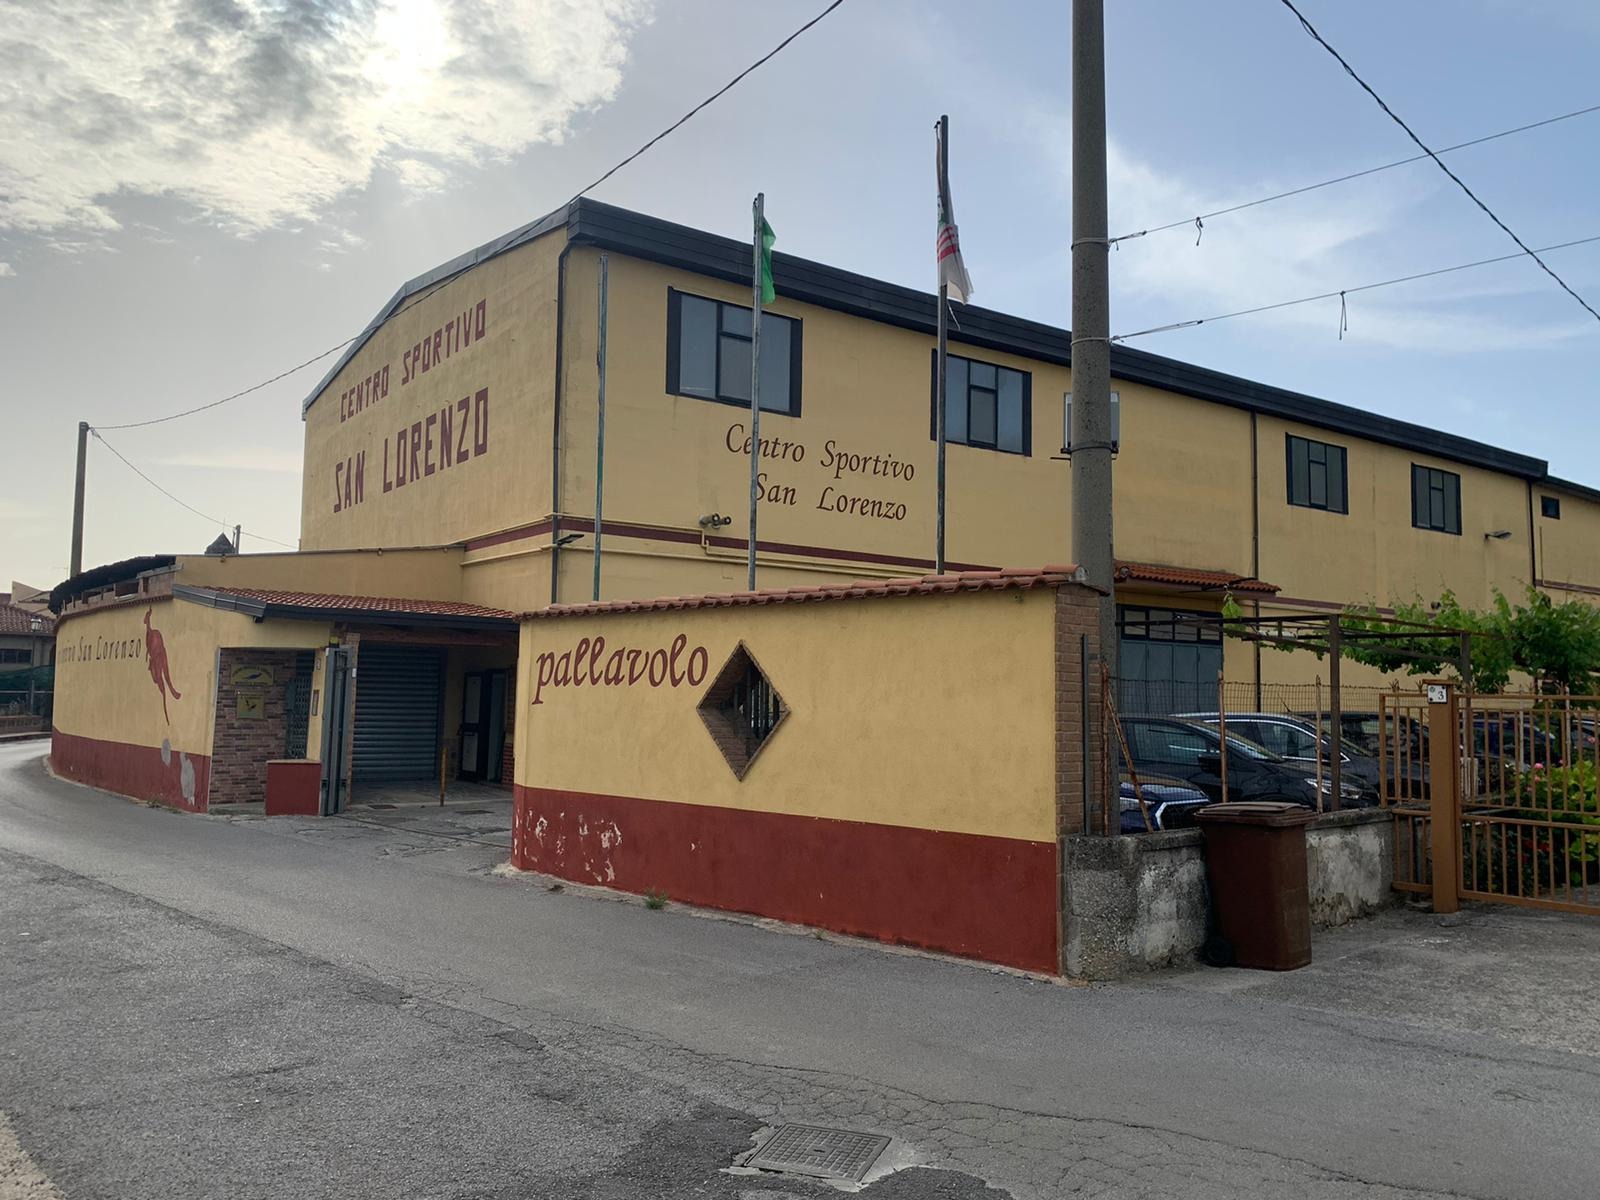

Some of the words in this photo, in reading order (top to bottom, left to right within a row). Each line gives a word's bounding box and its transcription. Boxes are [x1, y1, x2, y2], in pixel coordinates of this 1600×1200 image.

[340, 364, 390, 423] CENTRO
[401, 298, 487, 386] SPORTIVO
[333, 450, 366, 514] SAN
[383, 387, 489, 493] LORENZO
[726, 423, 805, 462] Centro
[820, 440, 915, 481] Sportivo
[755, 473, 797, 506] San
[816, 486, 907, 520] Lorenzo
[96, 635, 142, 660] Lorenzo
[531, 633, 709, 705] pallavolo
[1437, 690, 1445, 701] 3
